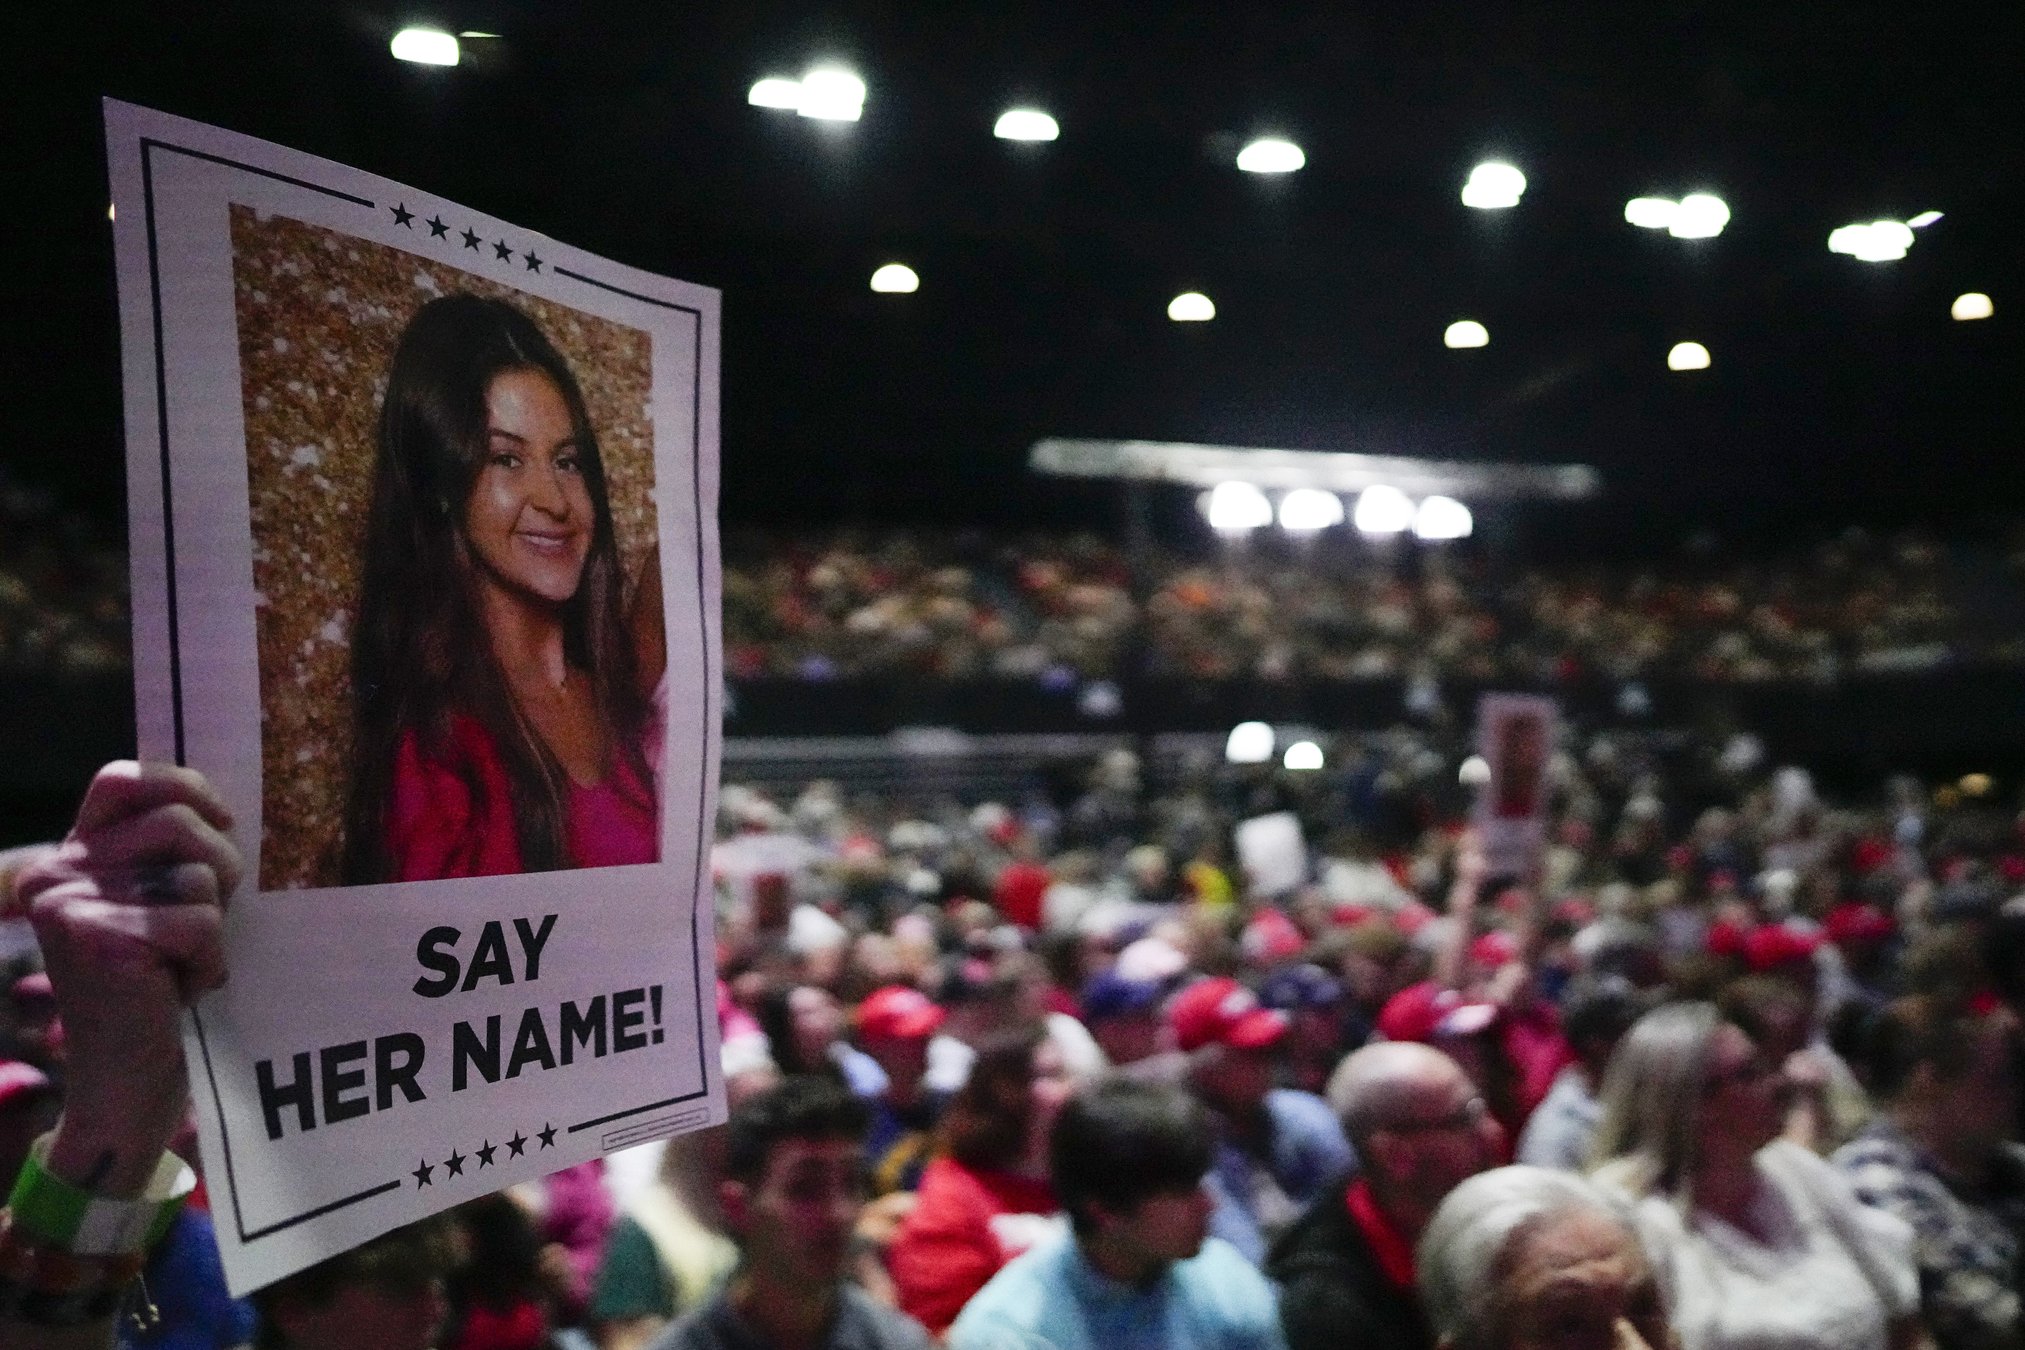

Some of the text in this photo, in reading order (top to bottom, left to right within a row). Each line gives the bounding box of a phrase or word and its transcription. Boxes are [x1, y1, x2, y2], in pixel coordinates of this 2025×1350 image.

[412, 914, 559, 998] SAY
[255, 985, 665, 1140] HER NAME!
